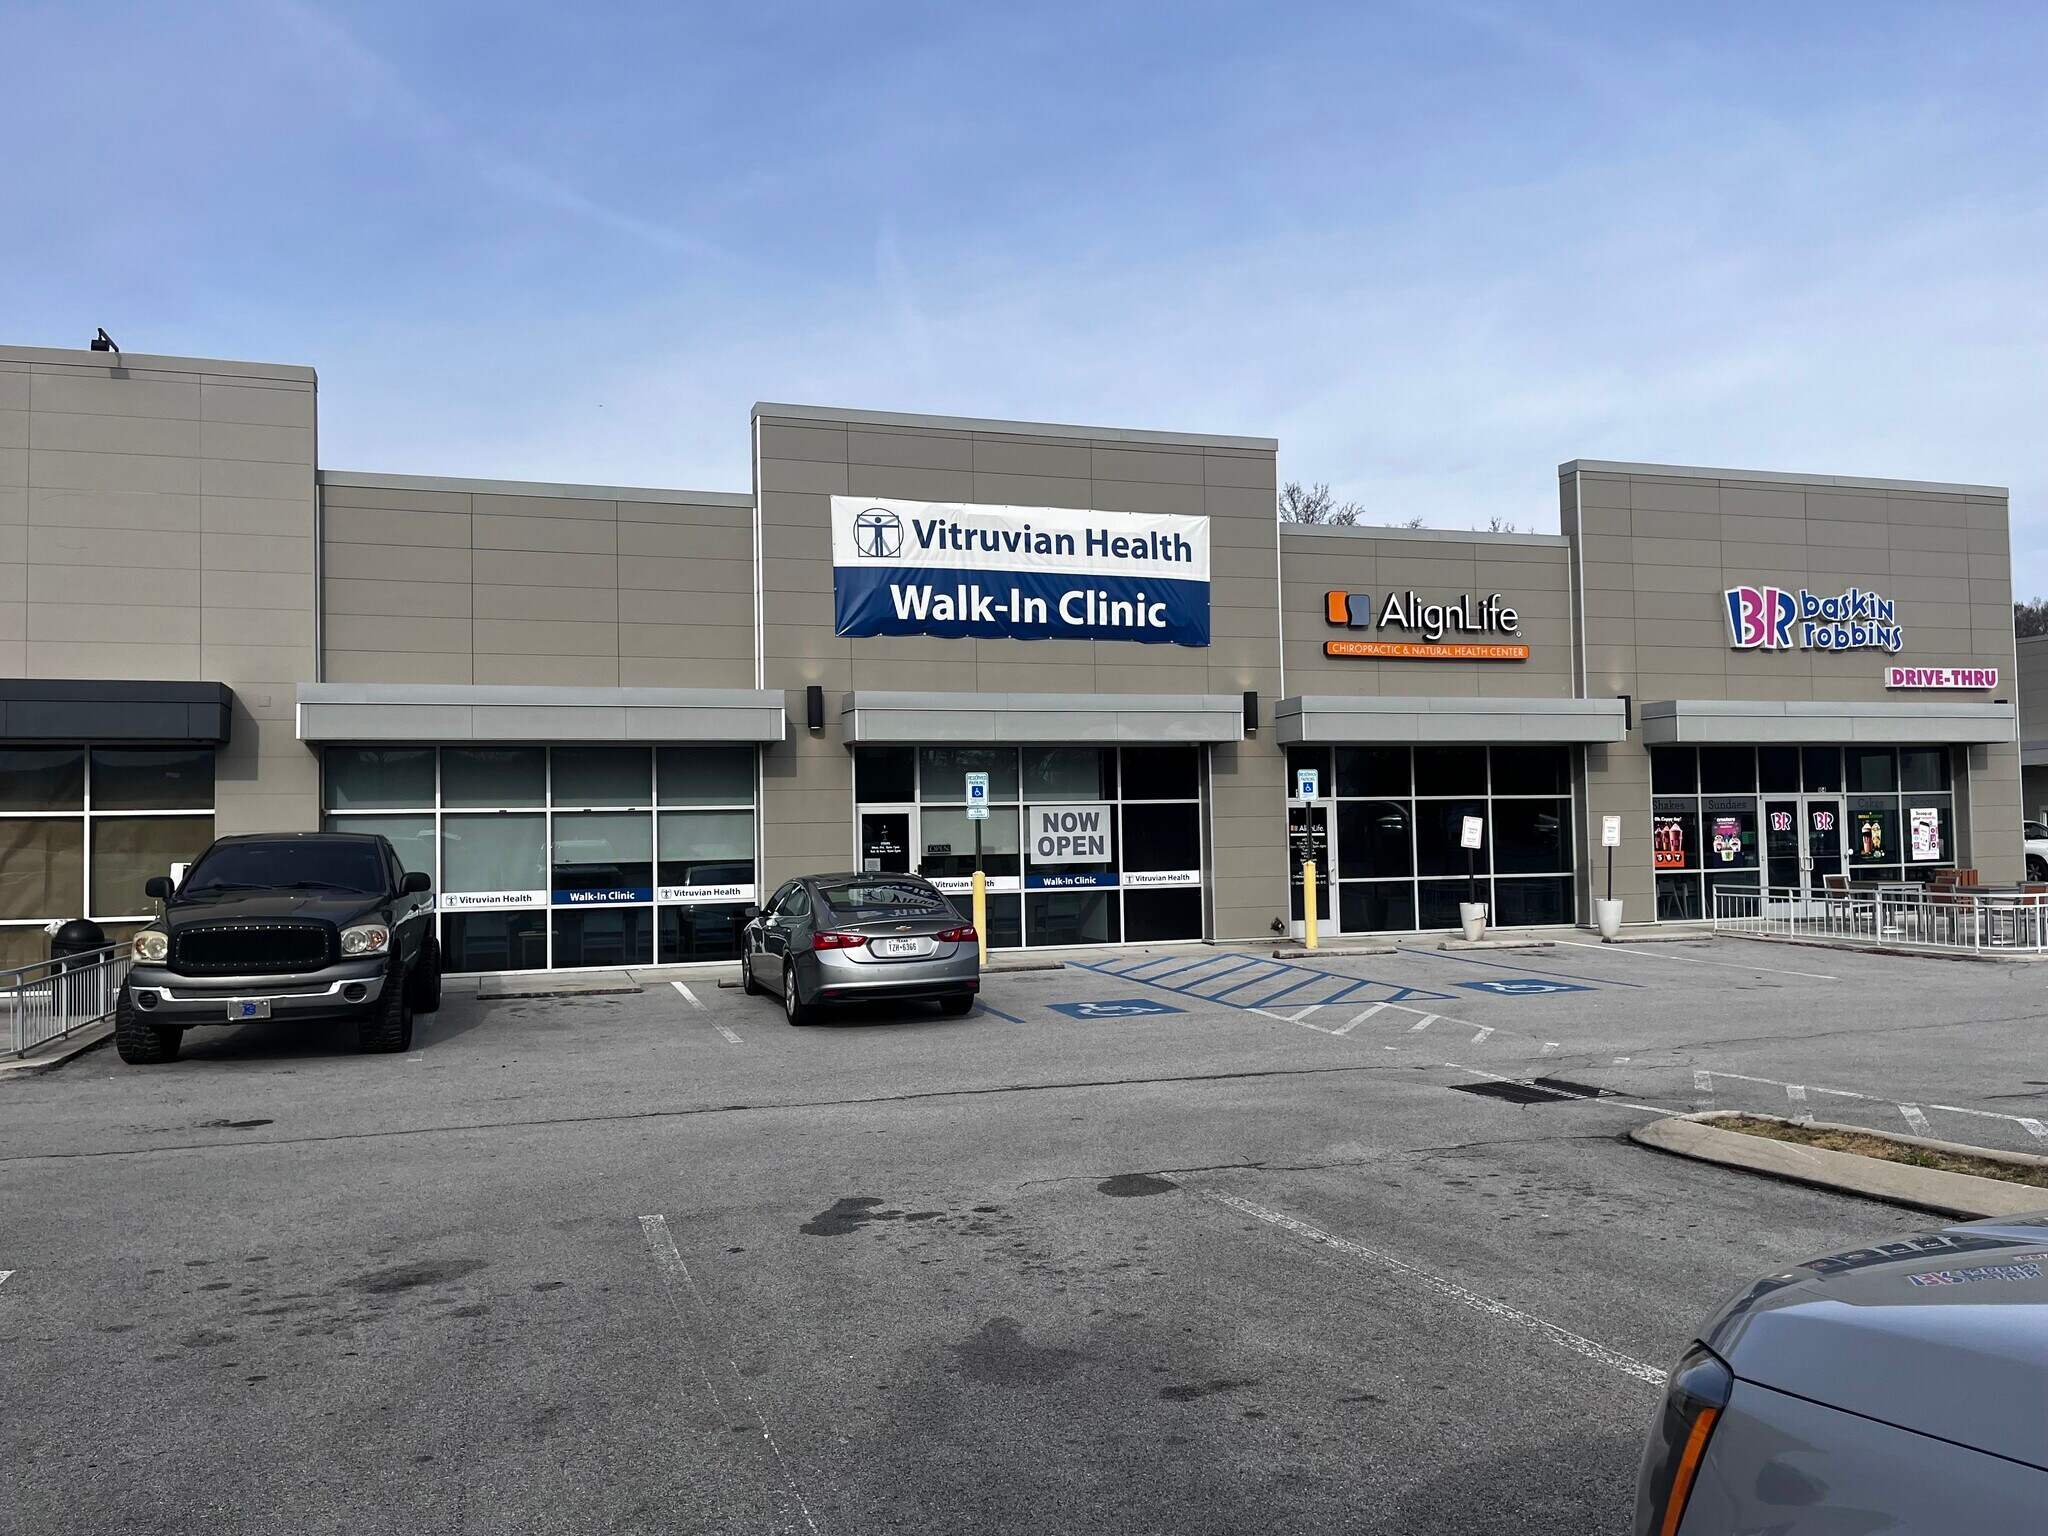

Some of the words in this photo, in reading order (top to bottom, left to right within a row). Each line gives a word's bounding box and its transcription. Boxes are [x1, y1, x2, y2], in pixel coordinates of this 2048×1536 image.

[912, 518, 1075, 556] Vitruvian
[1086, 528, 1192, 562] Health
[889, 584, 1047, 623] Walk-In
[1058, 589, 1167, 628] Clinic
[1379, 591, 1519, 640] AlignLife
[1724, 586, 1798, 649] BR
[1332, 643, 1400, 655] CHIROPRACTIC
[1402, 646, 1410, 655] &
[1412, 646, 1453, 656] NATURAL
[1454, 647, 1488, 656] HEALTH
[1490, 647, 1524, 657] CENTER
[1891, 668, 1997, 687] DRIVE-THRU
[1653, 798, 1685, 810] Shakes
[1708, 798, 1747, 810] Sundaes
[1043, 812, 1100, 832] NOW
[1770, 811, 1792, 831] BR
[1812, 811, 1834, 831] BR
[929, 844, 950, 852] OPEN
[1038, 835, 1104, 857] OPEN
[935, 880, 969, 888] Vitruvian
[1043, 877, 1074, 886] Walk-In
[1075, 876, 1097, 884] Clinic
[1135, 874, 1167, 882] Vitruvian
[1167, 873, 1190, 881] Health
[459, 895, 501, 904] Vitruvian
[502, 894, 532, 903] Health
[570, 891, 607, 901] Walk-In
[608, 891, 635, 900] Clinic
[673, 888, 712, 897] Vitruvian
[713, 887, 741, 896] Health
